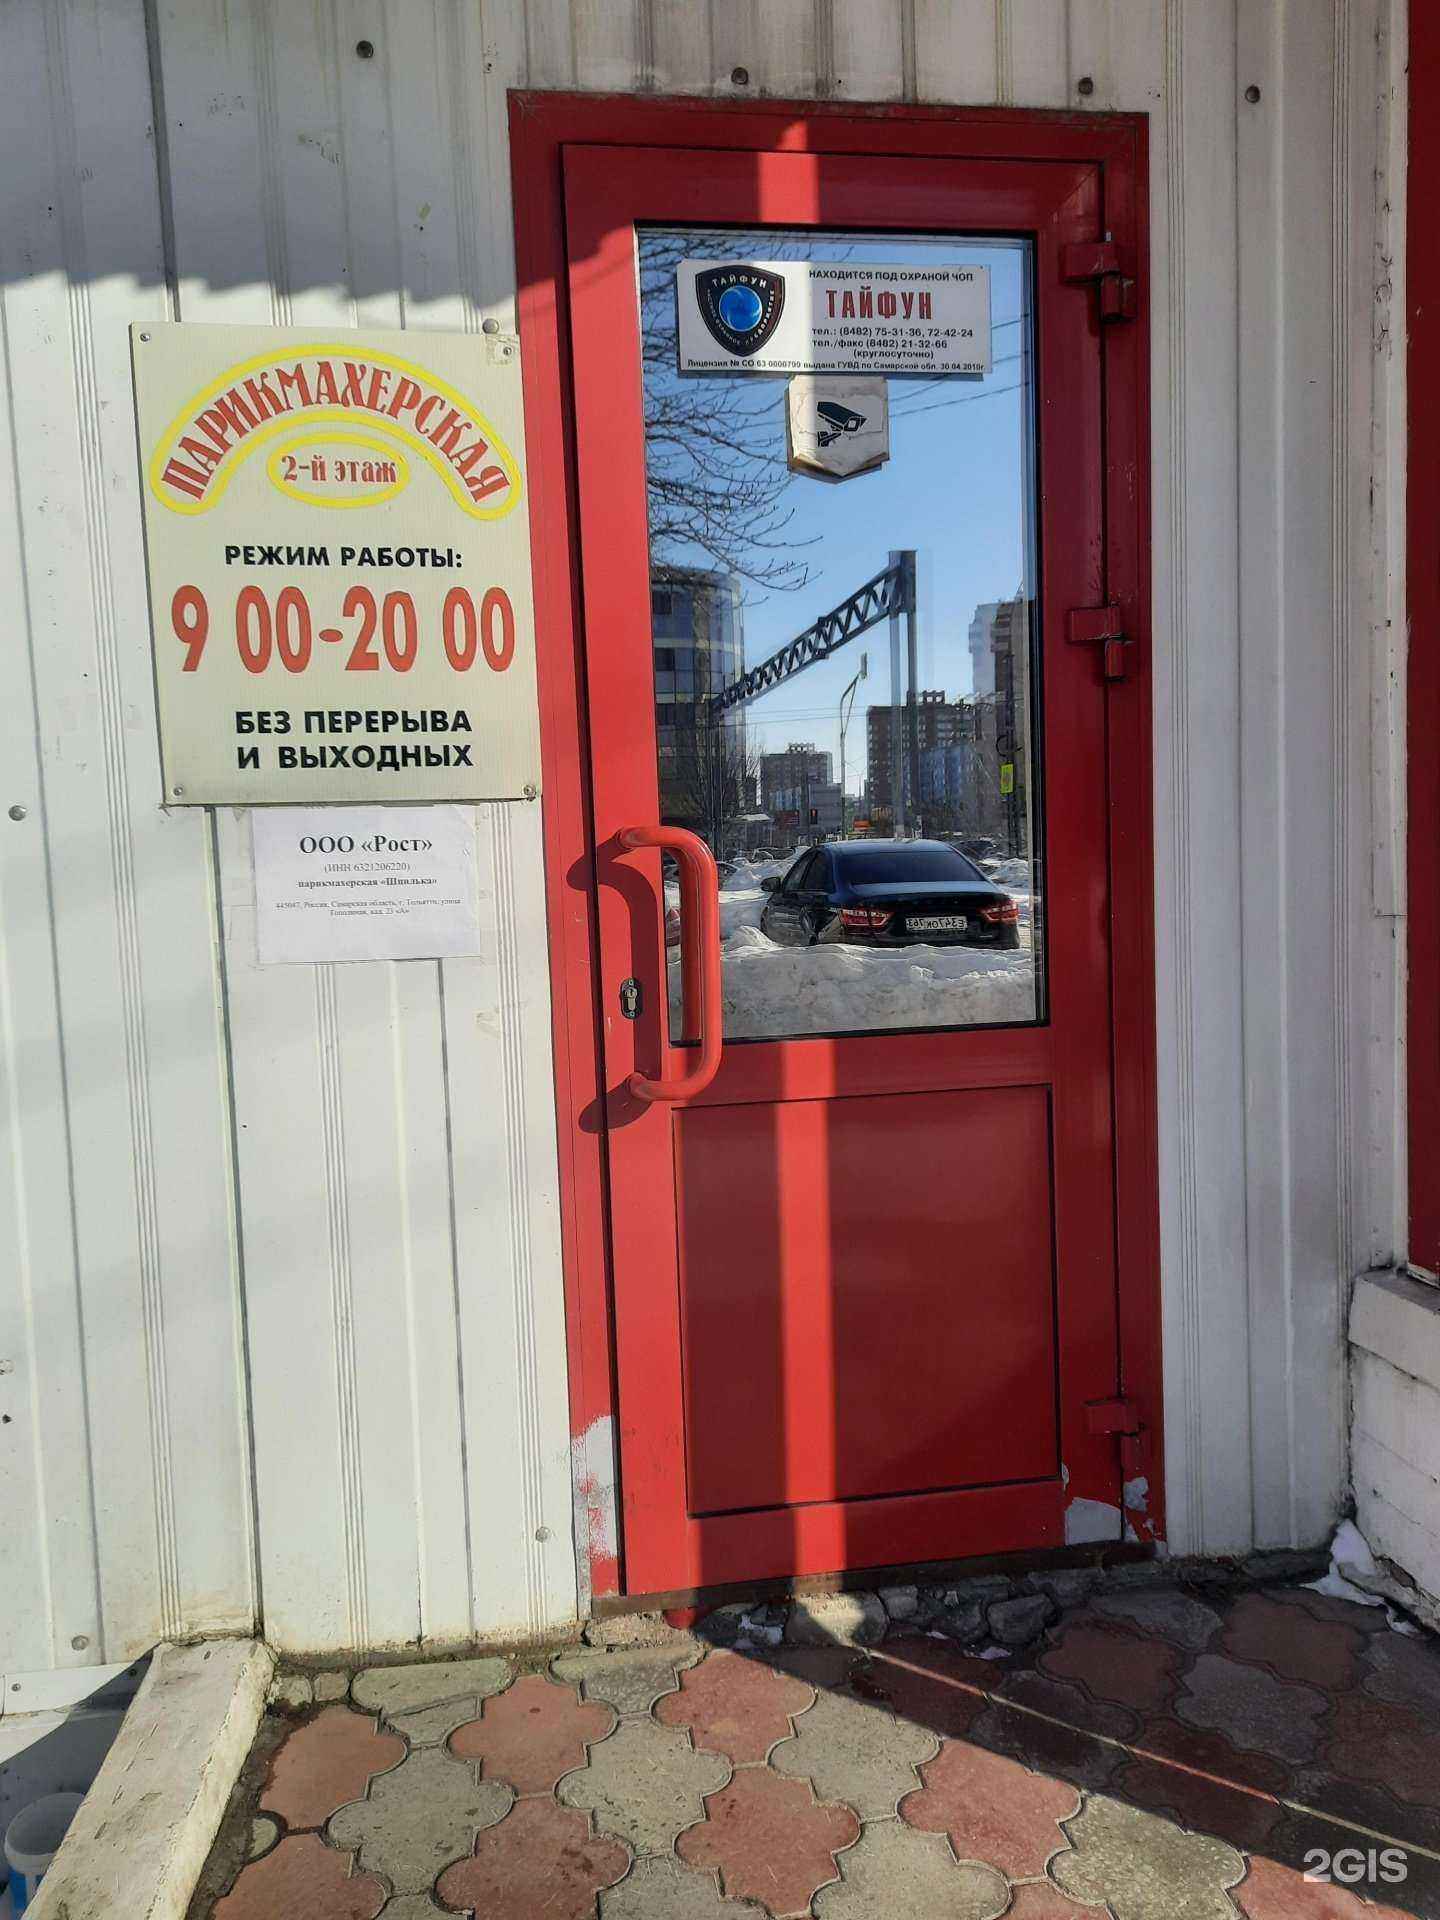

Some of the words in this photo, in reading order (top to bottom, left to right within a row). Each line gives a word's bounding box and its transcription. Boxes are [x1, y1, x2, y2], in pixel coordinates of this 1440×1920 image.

[711, 273, 768, 289] ТАЙФУН
[809, 269, 873, 281] НАХОДИТСЯ
[875, 270, 898, 281] ПОД
[899, 270, 950, 281] ОХРАНОЙ
[952, 272, 973, 282] ЧОП
[825, 285, 932, 320] ТАЙФУН
[811, 327, 837, 336] тел.:
[839, 326, 872, 338] (8482)
[875, 327, 925, 338] 75-31-36,
[927, 328, 973, 338] 72-42-24
[811, 338, 864, 349] тел./факс
[866, 338, 899, 350] (8482)
[901, 339, 948, 349] 21-32-66
[853, 350, 934, 360] (круглосуточно)
[687, 359, 728, 369] Лицензия
[730, 359, 740, 367] №
[741, 359, 755, 367] СО
[837, 361, 860, 371] ГУВД
[874, 361, 919, 371] Самарской
[160, 360, 512, 503] ПАРИКМАХЕРСКАЯ
[280, 454, 327, 483] 2-й
[334, 457, 398, 484] этаж
[224, 545, 331, 567] РЕЖИМ
[340, 546, 463, 568] РАБОТЫ:
[171, 584, 209, 672] 9
[442, 585, 516, 673] 00
[235, 710, 291, 735] БЕЗ
[304, 710, 473, 734] ПЕРЕРЫВА
[237, 746, 261, 770] И
[278, 744, 474, 772] ВЫХОДНЫХ
[299, 835, 355, 854] ООО
[360, 834, 433, 853] «Рост»
[323, 862, 352, 874] (ИНН
[297, 878, 378, 890] парикмахерская
[380, 876, 437, 888] «Шпилька»
